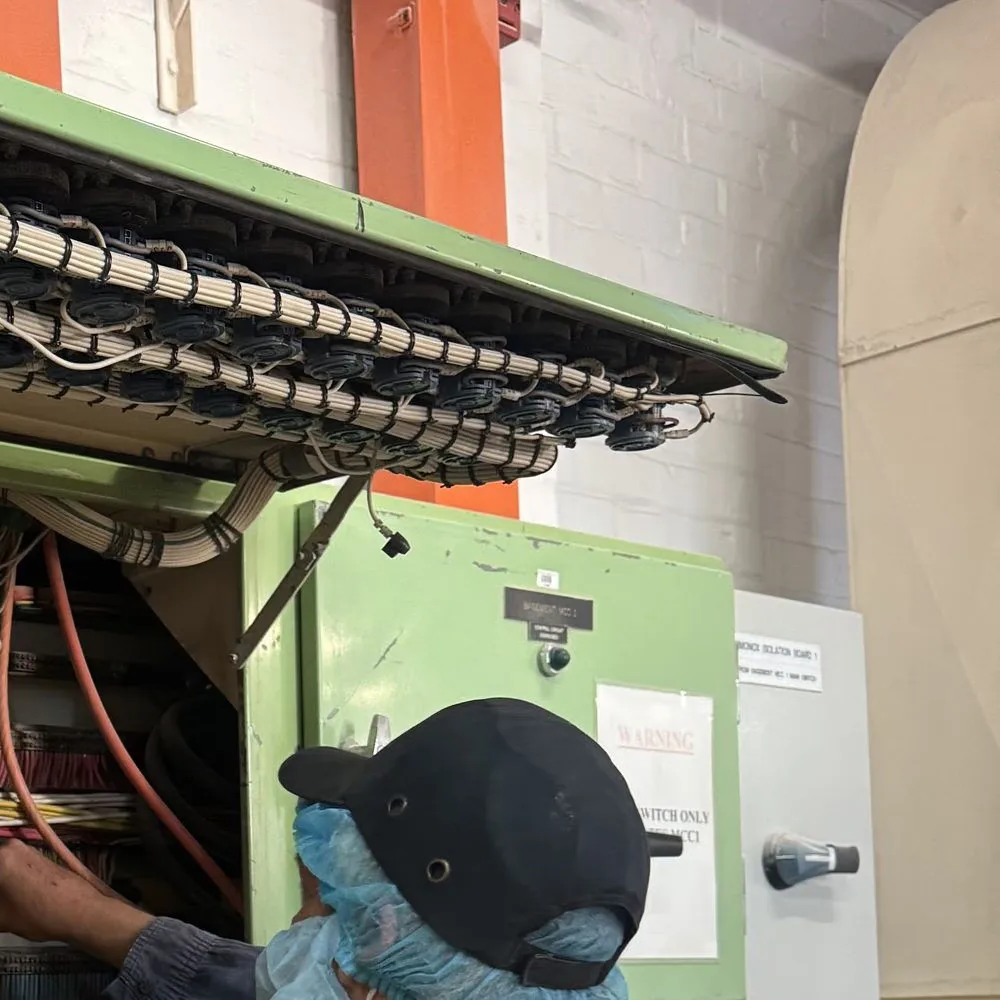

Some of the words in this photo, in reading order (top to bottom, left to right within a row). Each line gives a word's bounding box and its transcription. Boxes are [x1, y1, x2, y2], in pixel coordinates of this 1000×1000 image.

[618, 726, 694, 750] WARNING
[640, 807, 677, 822] WITCH
[680, 810, 710, 824] ONLY
